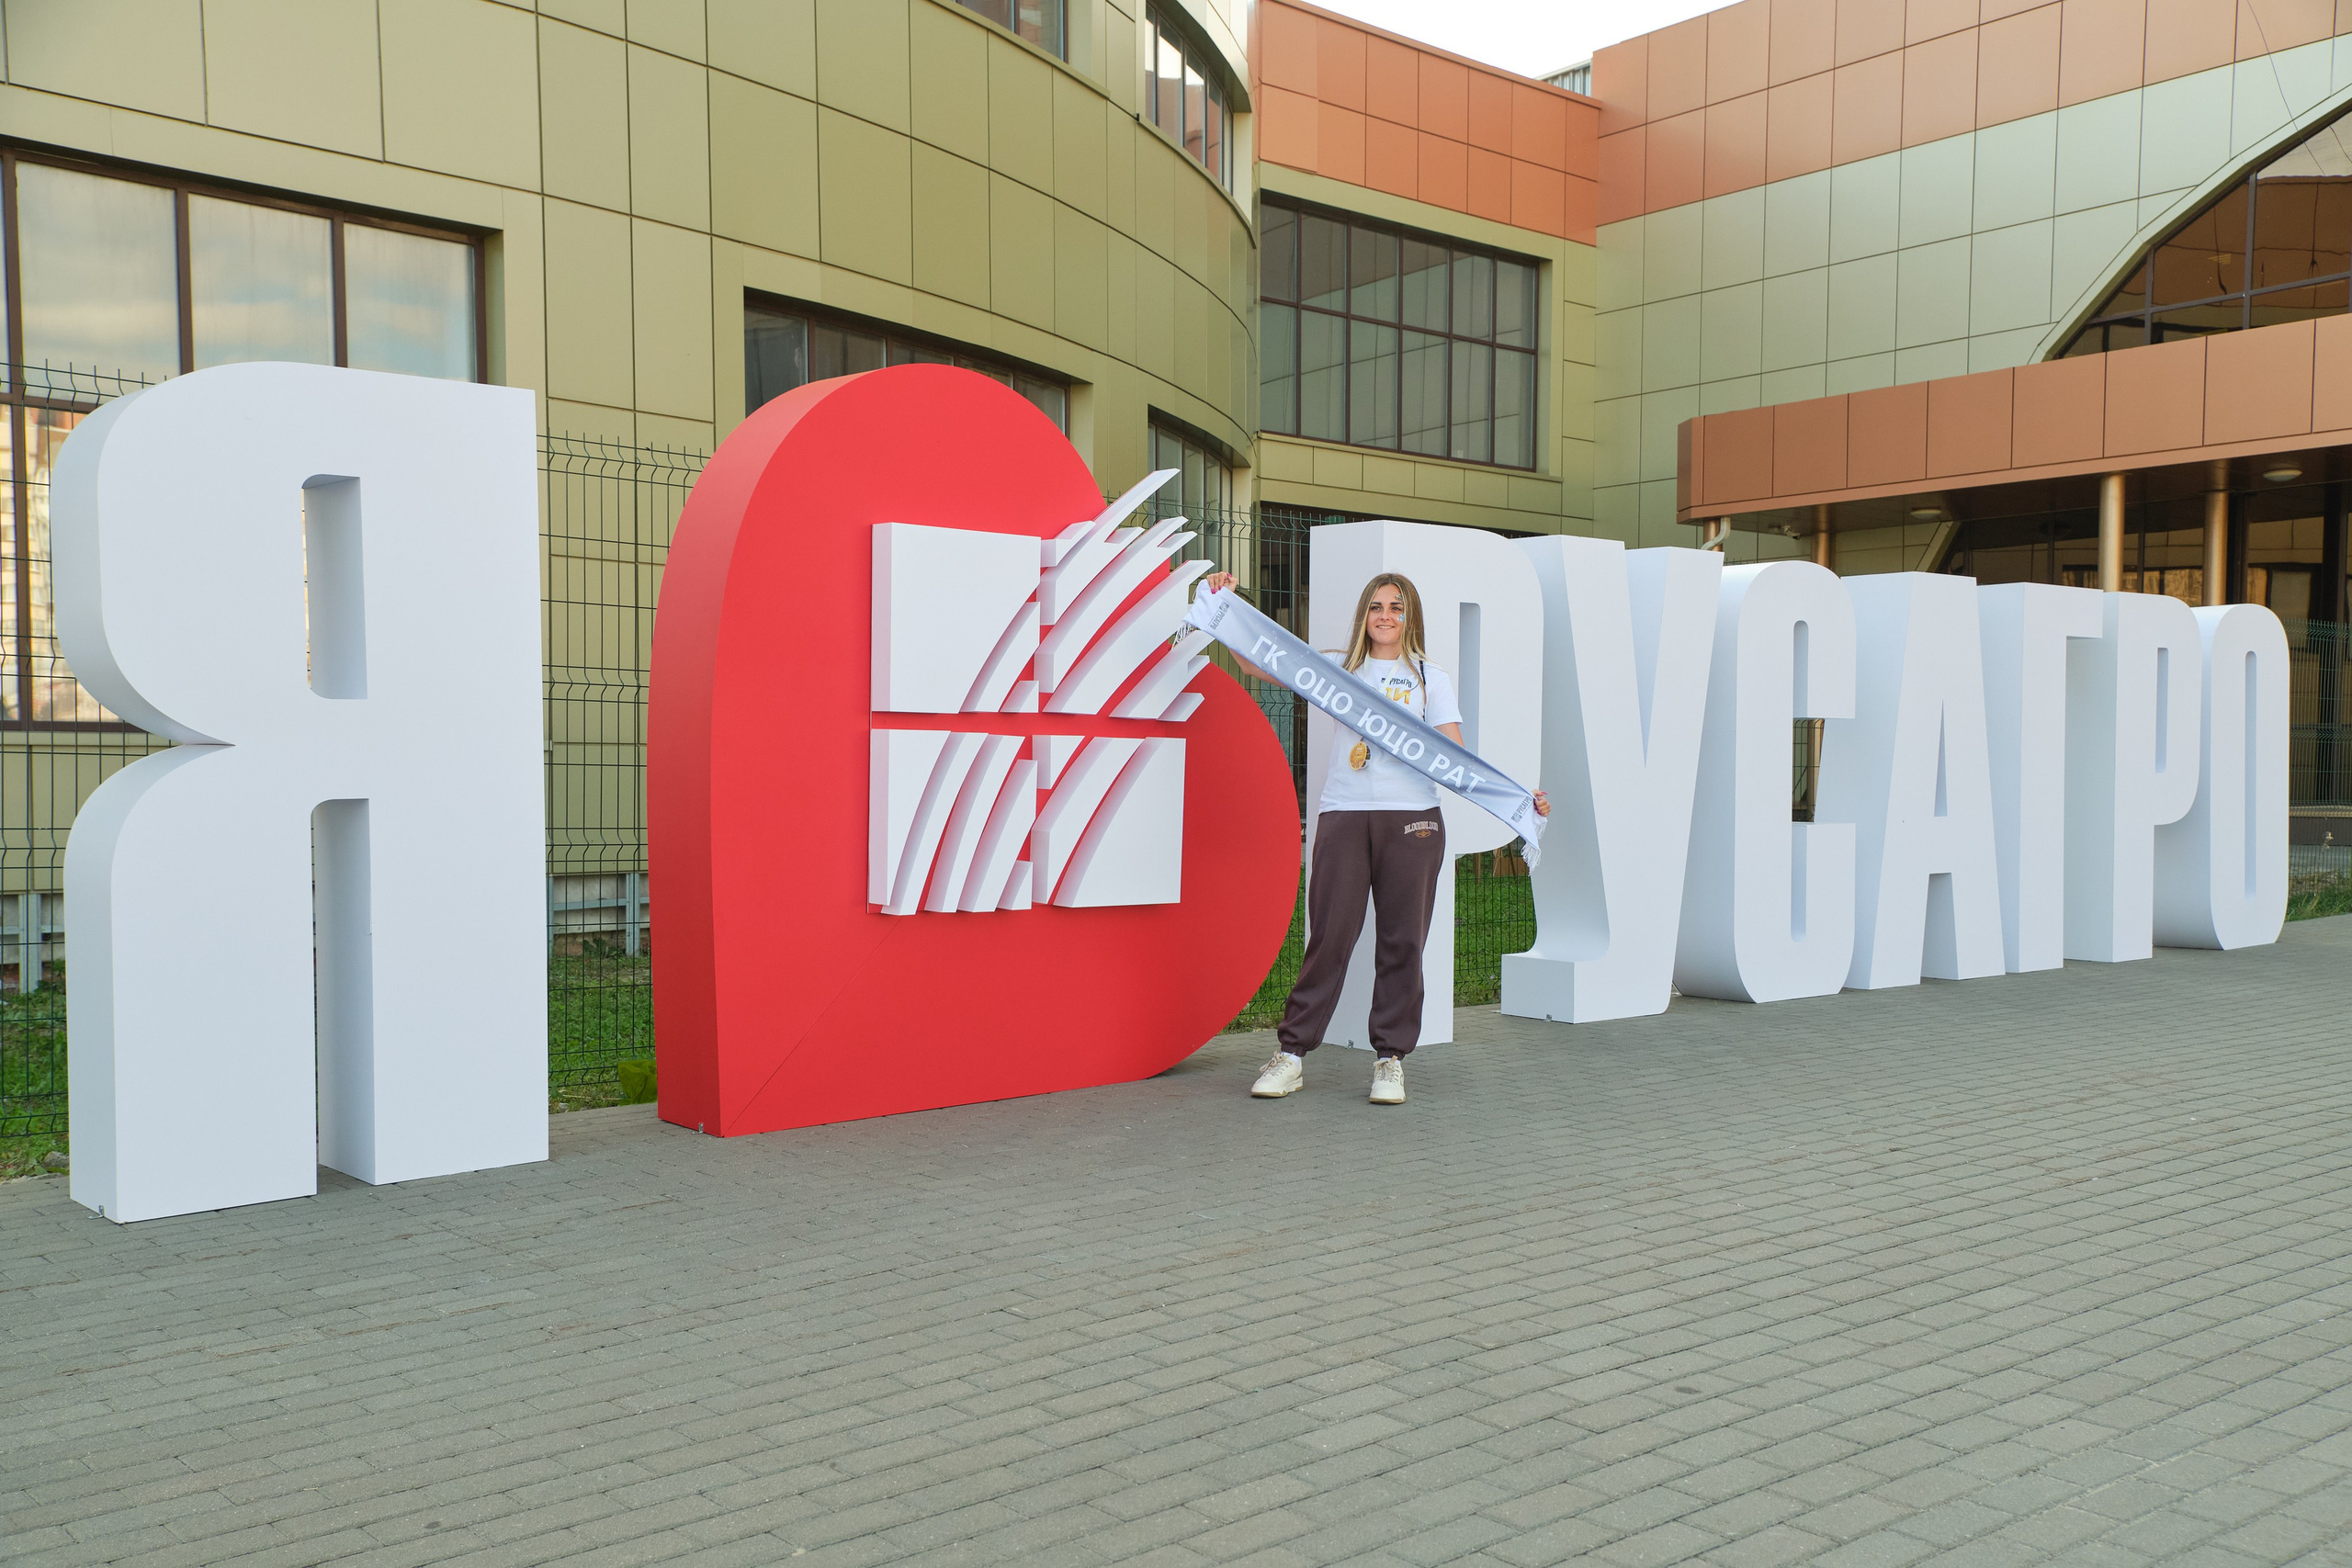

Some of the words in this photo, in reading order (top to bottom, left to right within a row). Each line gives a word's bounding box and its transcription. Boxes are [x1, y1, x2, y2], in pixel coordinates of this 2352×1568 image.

[1250, 635, 1287, 671] ГК
[1295, 667, 1353, 715] ОЦО
[1357, 707, 1425, 761] ЮЦО
[1428, 753, 1486, 794] РАТ
[1389, 677, 1412, 688] РУСАГРО
[51, 361, 548, 1224] Я
[1308, 520, 2290, 1048] РУСАГРО
